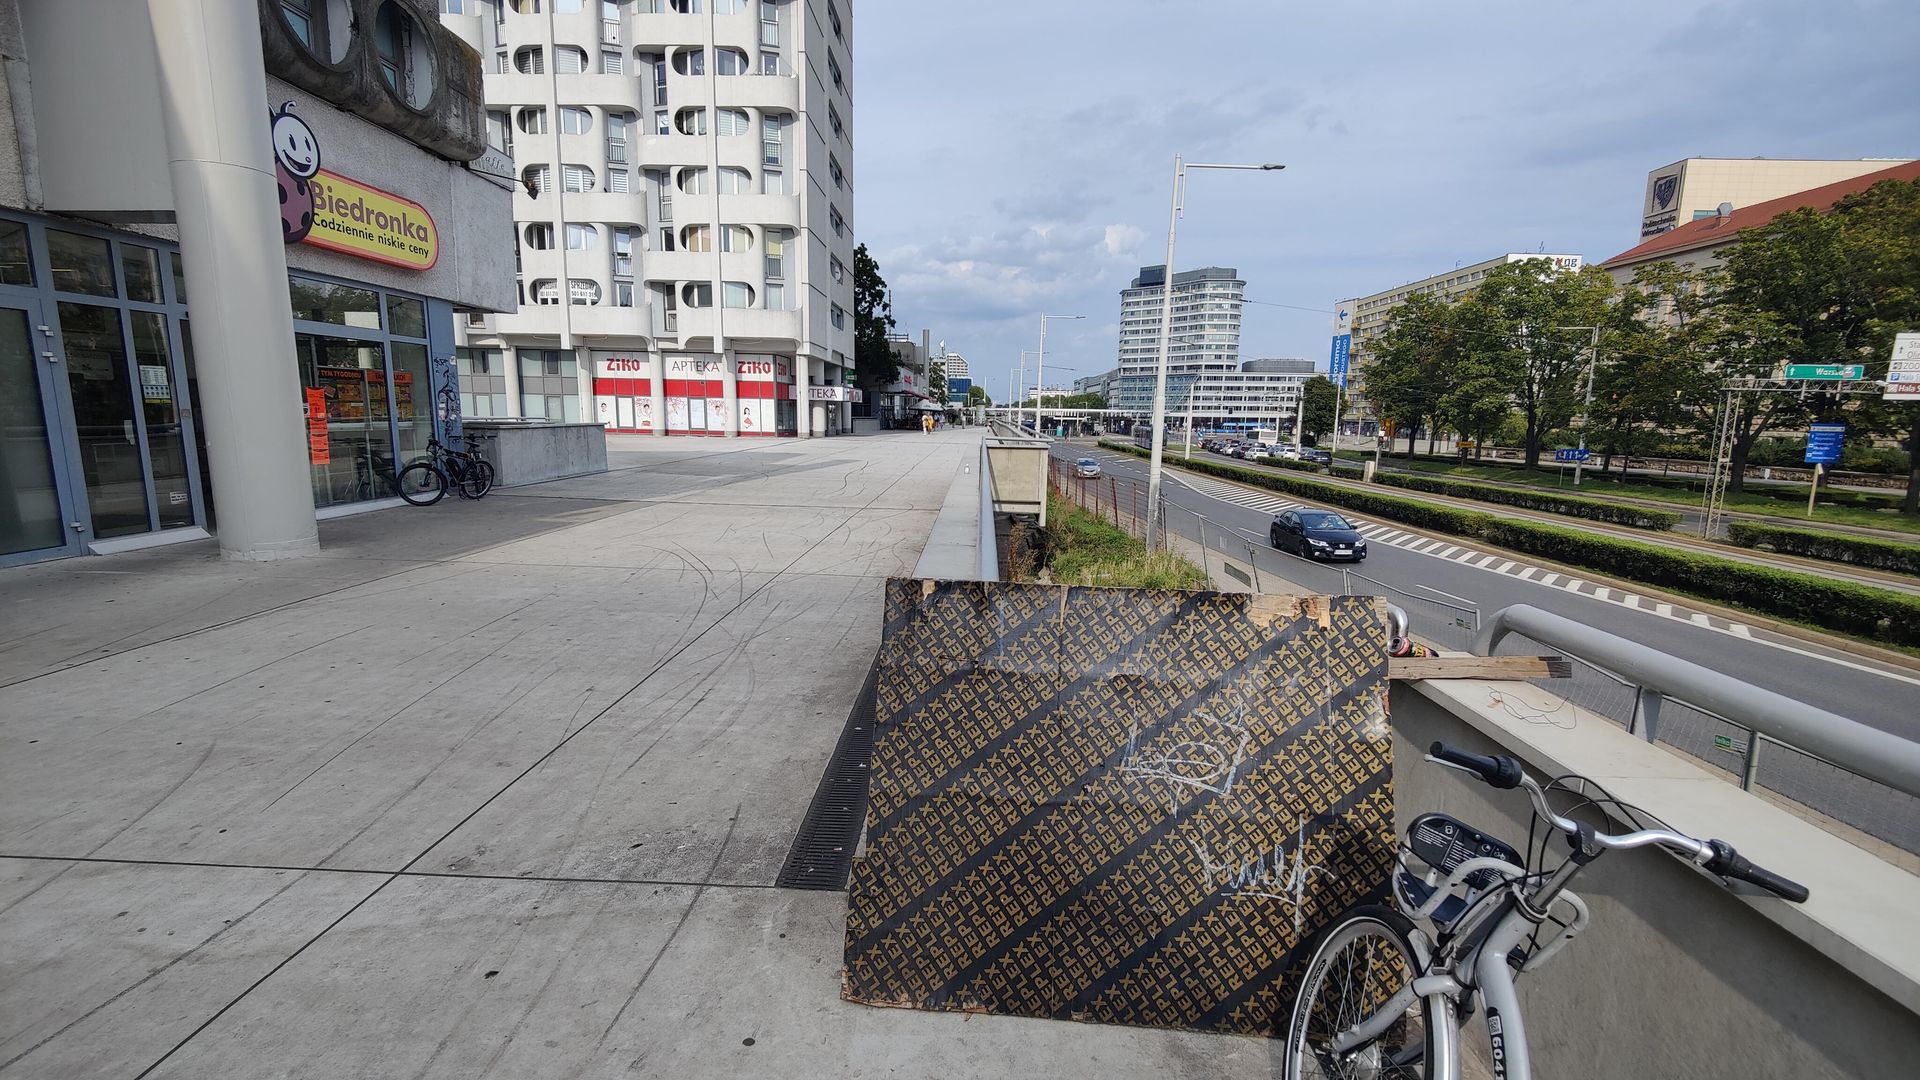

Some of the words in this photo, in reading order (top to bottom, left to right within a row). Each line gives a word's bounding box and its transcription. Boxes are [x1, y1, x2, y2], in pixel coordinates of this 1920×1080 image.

[309, 179, 429, 243] Biedronka
[312, 212, 375, 242] Codziennie
[378, 233, 405, 251] niskie
[408, 244, 429, 259] ceny
[671, 360, 720, 373] APTEKA
[809, 388, 838, 399] TEKA
[911, 617, 956, 675] REPLEX
[937, 599, 982, 656] REPLEX
[950, 589, 995, 647] REPLEX
[1046, 614, 1094, 672] REPLEX
[1058, 604, 1106, 663] REPLEX
[1072, 595, 1120, 654] REPLEX
[1171, 620, 1221, 679] REPLEX
[1184, 610, 1235, 670] REPLEX
[1198, 601, 1249, 660] REPLEX
[1211, 592, 1262, 651] REPLEX
[1328, 606, 1382, 666] REPLEX
[885, 635, 930, 694] REPLEX
[898, 626, 943, 684] REPLEX
[994, 651, 1041, 711] REPLEX
[1007, 642, 1055, 701] REPLEX
[1020, 632, 1067, 691] REPLEX
[1033, 623, 1080, 682] REPLEX
[1132, 648, 1182, 708] REPLEX
[1145, 638, 1195, 699] REPLEX
[1158, 629, 1209, 689] REPLEX
[1275, 645, 1328, 706] REPLEX
[1289, 635, 1342, 696] REPLEX
[1302, 626, 1356, 686] REPLEX
[954, 679, 1001, 739] REPLEX
[968, 670, 1015, 730] REPLEX
[981, 660, 1028, 720] REPLEX
[1079, 686, 1128, 747] REPLEX
[1092, 676, 1142, 737] REPLEX
[1106, 667, 1155, 728] REPLEX
[1119, 658, 1169, 718] REPLEX
[1235, 674, 1287, 735] REPLEX
[1248, 664, 1301, 726] REPLEX
[1262, 655, 1315, 716] REPLEX
[901, 717, 948, 778] REPLEX
[915, 707, 961, 768] REPLEX
[928, 698, 975, 759] REPLEX
[941, 689, 988, 749] REPLEX
[1039, 714, 1088, 776] REPLEX
[1053, 705, 1102, 767] REPLEX
[1066, 695, 1115, 757] REPLEX
[1328, 710, 1383, 774] REPLEX
[875, 736, 920, 798] REPLEX
[888, 726, 934, 788] REPLEX
[1000, 743, 1048, 806] REPLEX
[1013, 733, 1062, 796] REPLEX
[1026, 724, 1075, 786] REPLEX
[1273, 750, 1328, 814] REPLEX
[1287, 740, 1341, 804] REPLEX
[1301, 730, 1355, 794] REPLEX
[1314, 720, 1369, 784] REPLEX
[946, 782, 994, 846] REPLEX
[960, 772, 1008, 836] REPLEX
[973, 763, 1021, 826] REPLEX
[986, 753, 1035, 816] REPLEX
[1087, 780, 1138, 845] REPLEX
[1100, 770, 1151, 835] REPLEX
[1114, 761, 1165, 825] REPLEX
[1233, 779, 1286, 845] REPLEX
[1246, 769, 1300, 835] REPLEX
[1260, 759, 1314, 824] REPLEX
[905, 812, 953, 876] REPLEX
[919, 802, 967, 866] REPLEX
[932, 792, 980, 856] REPLEX
[1033, 820, 1083, 886] REPLEX
[1046, 810, 1097, 875] REPLEX
[1060, 800, 1111, 865] REPLEX
[1074, 790, 1124, 855] REPLEX
[1178, 819, 1231, 885] REPLEX
[1191, 809, 1245, 875] REPLEX
[1205, 799, 1259, 865] REPLEX
[1219, 789, 1273, 855] REPLEX
[1328, 818, 1385, 886] REPLEX
[1342, 808, 1397, 875] REPLEX
[864, 842, 911, 908] REPLEX
[878, 832, 925, 897] REPLEX
[892, 822, 939, 887] REPLEX
[992, 850, 1042, 916] REPLEX
[1006, 840, 1056, 906] REPLEX
[1020, 830, 1070, 896] REPLEX
[1137, 849, 1190, 916] REPLEX
[1150, 839, 1203, 906] REPLEX
[1164, 829, 1217, 896] REPLEX
[937, 891, 986, 959] REPLEX
[951, 881, 1000, 948] REPLEX
[965, 870, 1014, 937] REPLEX
[979, 860, 1028, 927] REPLEX
[1082, 889, 1134, 958] REPLEX
[1096, 879, 1148, 948] REPLEX
[1109, 869, 1162, 937] REPLEX
[1123, 859, 1175, 927] REPLEX
[1231, 890, 1286, 959] REPLEX
[1244, 880, 1300, 949] REPLEX
[895, 922, 943, 991] REPLEX
[909, 912, 958, 980] REPLEX
[923, 901, 972, 969] REPLEX
[1027, 931, 1078, 1000] REPLEX
[1040, 920, 1092, 990] REPLEX
[1054, 910, 1106, 979] REPLEX
[1068, 900, 1120, 969] REPLEX
[1175, 930, 1229, 1001] REPLEX
[1189, 921, 1244, 991] REPLEX
[1203, 910, 1257, 980] REPLEX
[1217, 900, 1272, 969] REPLEX
[881, 933, 929, 1001] REPLEX
[1012, 942, 1063, 1011] REPLEX
[1147, 952, 1201, 1023] REPLEX
[1161, 941, 1215, 1012] REPLEX
